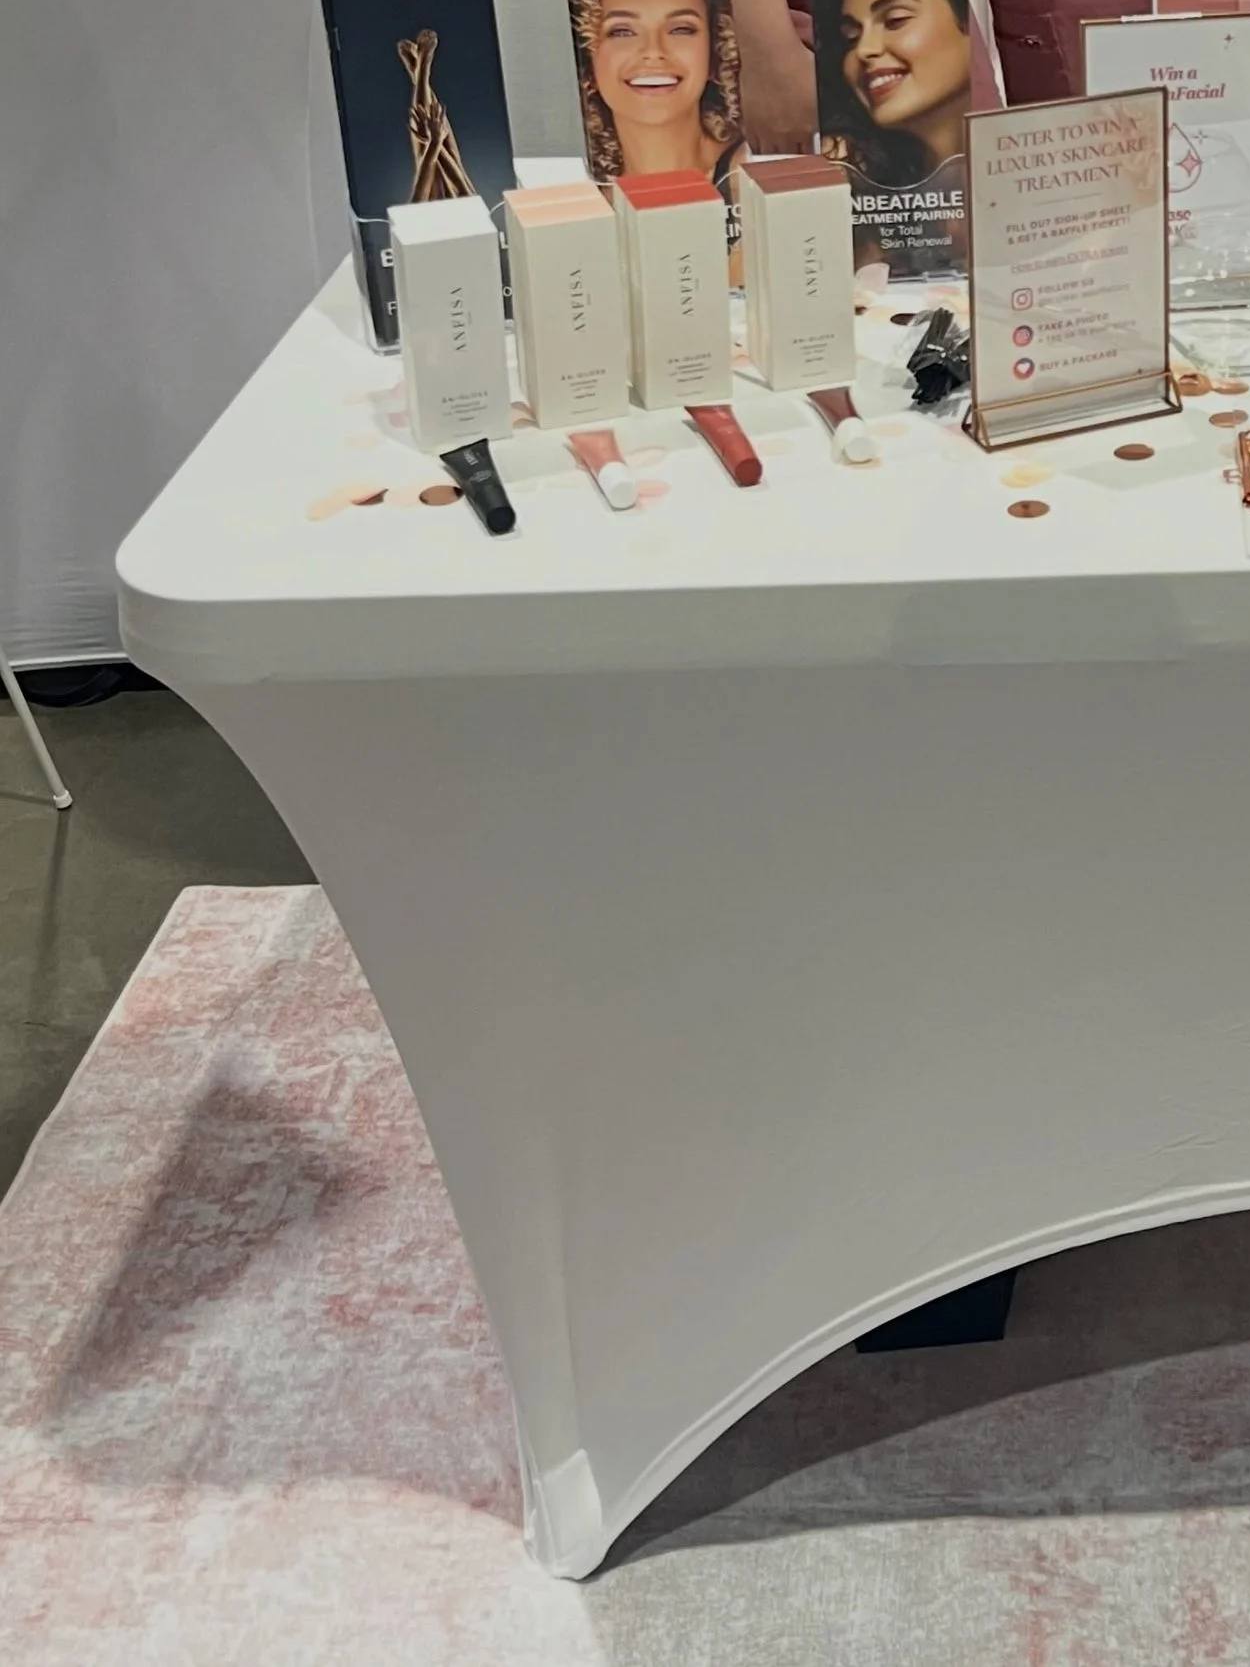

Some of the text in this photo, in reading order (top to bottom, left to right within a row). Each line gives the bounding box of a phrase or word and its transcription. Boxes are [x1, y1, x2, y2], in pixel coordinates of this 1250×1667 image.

[1149, 66, 1198, 81] Win a
[997, 129, 1054, 151] ENTER
[1057, 125, 1084, 142] TO
[1085, 119, 1125, 137] WIN
[986, 137, 1149, 176] LUXURY SKINCARE
[1014, 163, 1123, 194] TREATMENT
[851, 190, 964, 212] NBEATABLE
[852, 209, 966, 225] EATMENT PAIRING
[1006, 204, 1132, 234] FILL OUT SIGN-UP SHEET
[1168, 210, 1192, 222] 350
[880, 224, 923, 237] for Total
[1051, 224, 1088, 238] RAFFLE
[881, 234, 953, 250] Skin Renewal
[1037, 279, 1079, 295] FOLLOW
[1037, 320, 1064, 333] TAKE
[1075, 313, 1110, 326] PHOTO
[1039, 360, 1060, 372] BUY
[1071, 348, 1119, 365] PACKAGE
